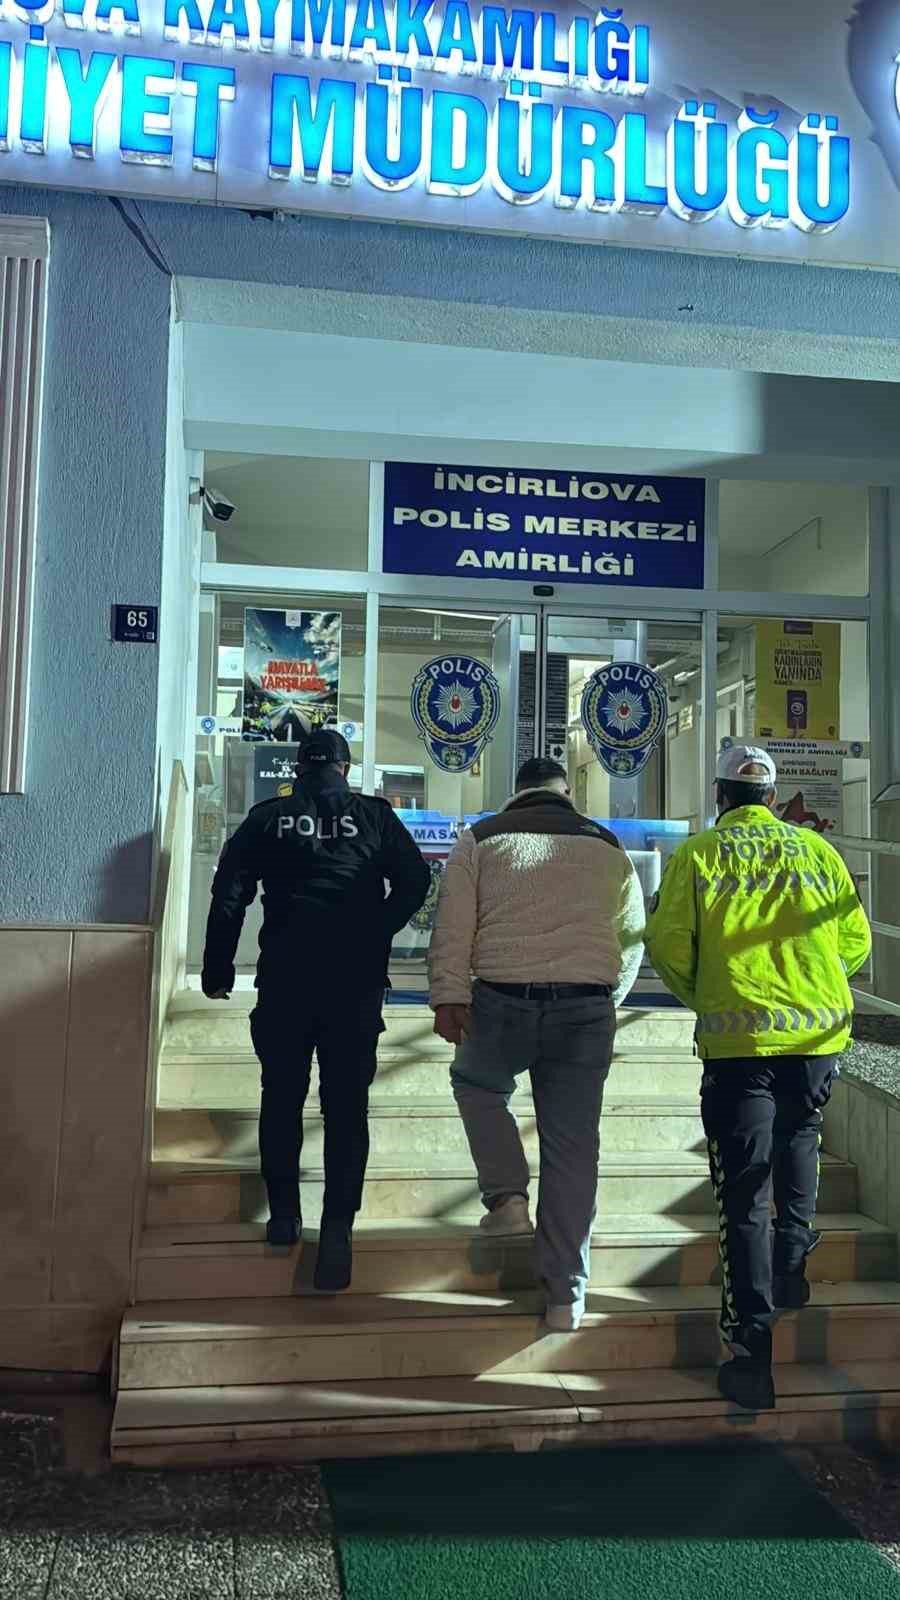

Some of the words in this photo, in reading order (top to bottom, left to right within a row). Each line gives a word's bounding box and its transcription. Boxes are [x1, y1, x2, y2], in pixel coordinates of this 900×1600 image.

[0, 24, 236, 162] İYET
[269, 63, 851, 225] MÜDÜRLÜĞÜ
[433, 467, 661, 503] İNCİRLİOVA
[393, 507, 511, 532] POLİS
[524, 514, 698, 542] MERKEZİ
[455, 548, 635, 577] AMİRLİĞİ
[127, 610, 148, 628] 65
[428, 659, 486, 682] POLİS
[597, 666, 653, 689] POLİS
[277, 815, 359, 839] POLİS
